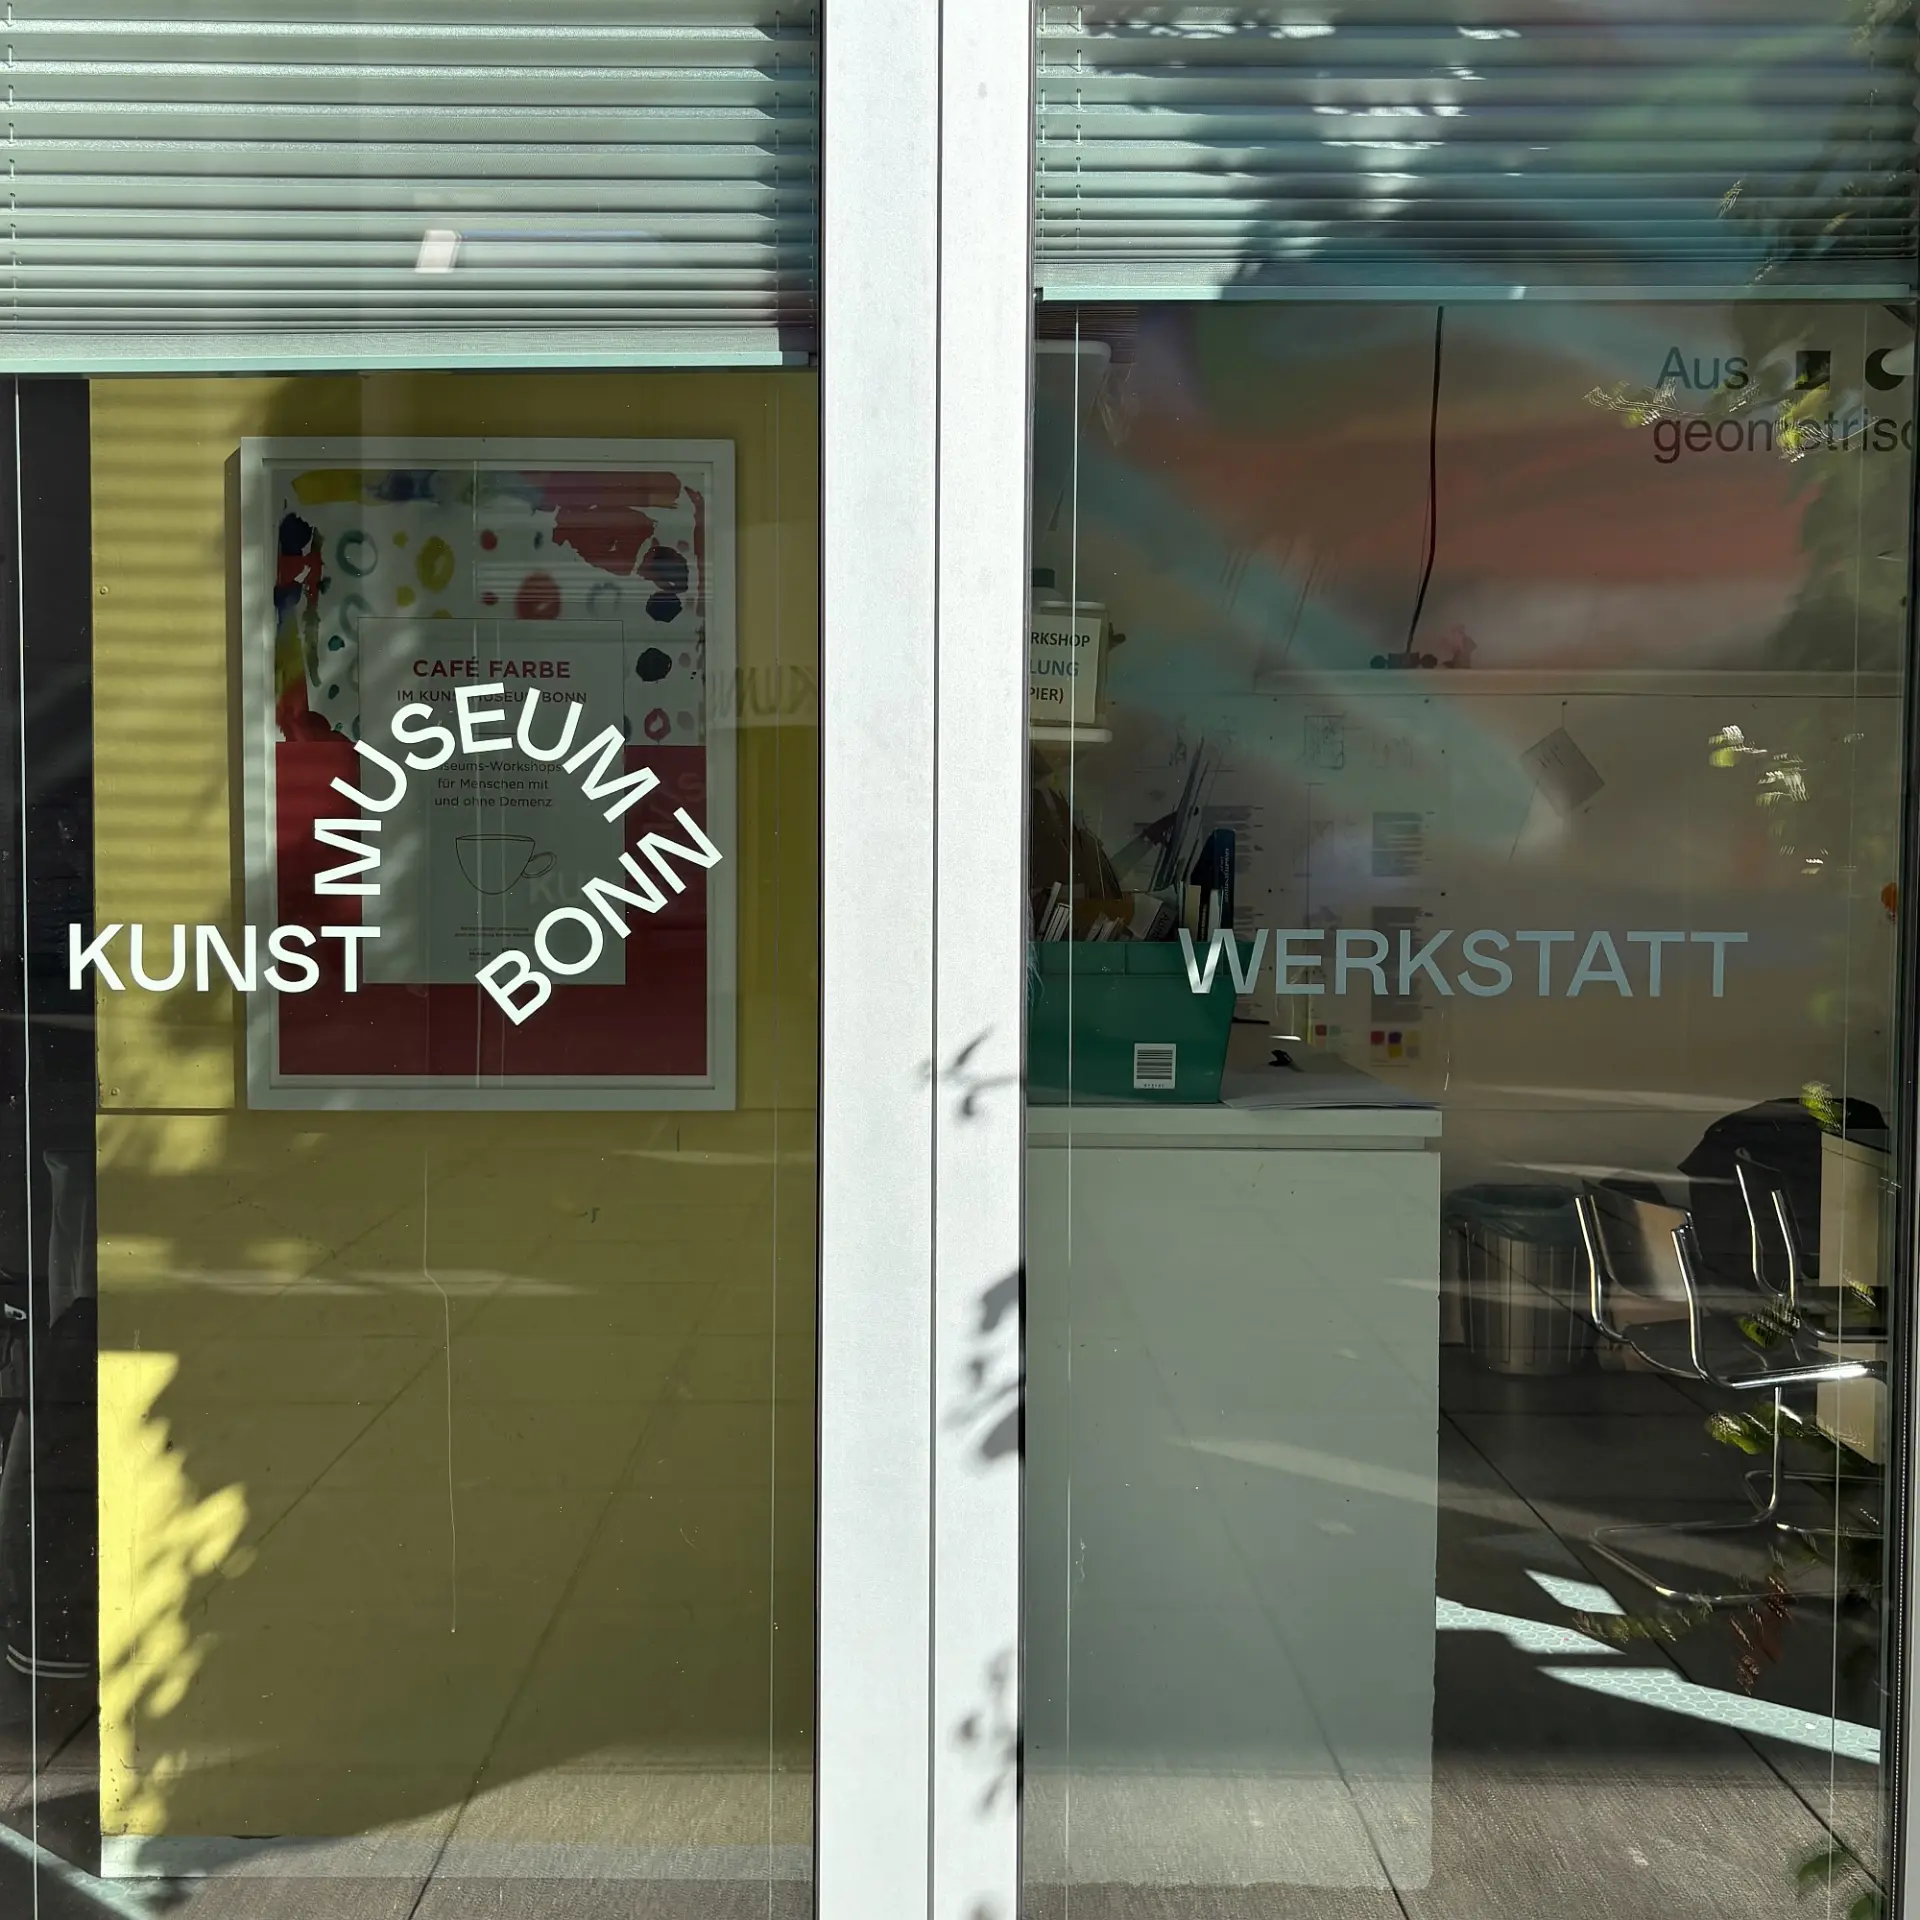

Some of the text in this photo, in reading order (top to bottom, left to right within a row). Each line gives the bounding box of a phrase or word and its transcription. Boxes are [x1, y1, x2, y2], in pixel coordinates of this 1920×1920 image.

[1656, 346, 1750, 390] Aus
[413, 656, 571, 679] CAFÉ FARBE
[397, 690, 587, 704] IM KUNUSEU BONN
[434, 760, 562, 775] seums-Workshops
[438, 778, 549, 790] für Menschen mit
[434, 796, 553, 807] und ohne Demenz
[69, 683, 723, 1026] KUNST MUSEUM BONN
[1178, 927, 1749, 999] WERKSTATT
